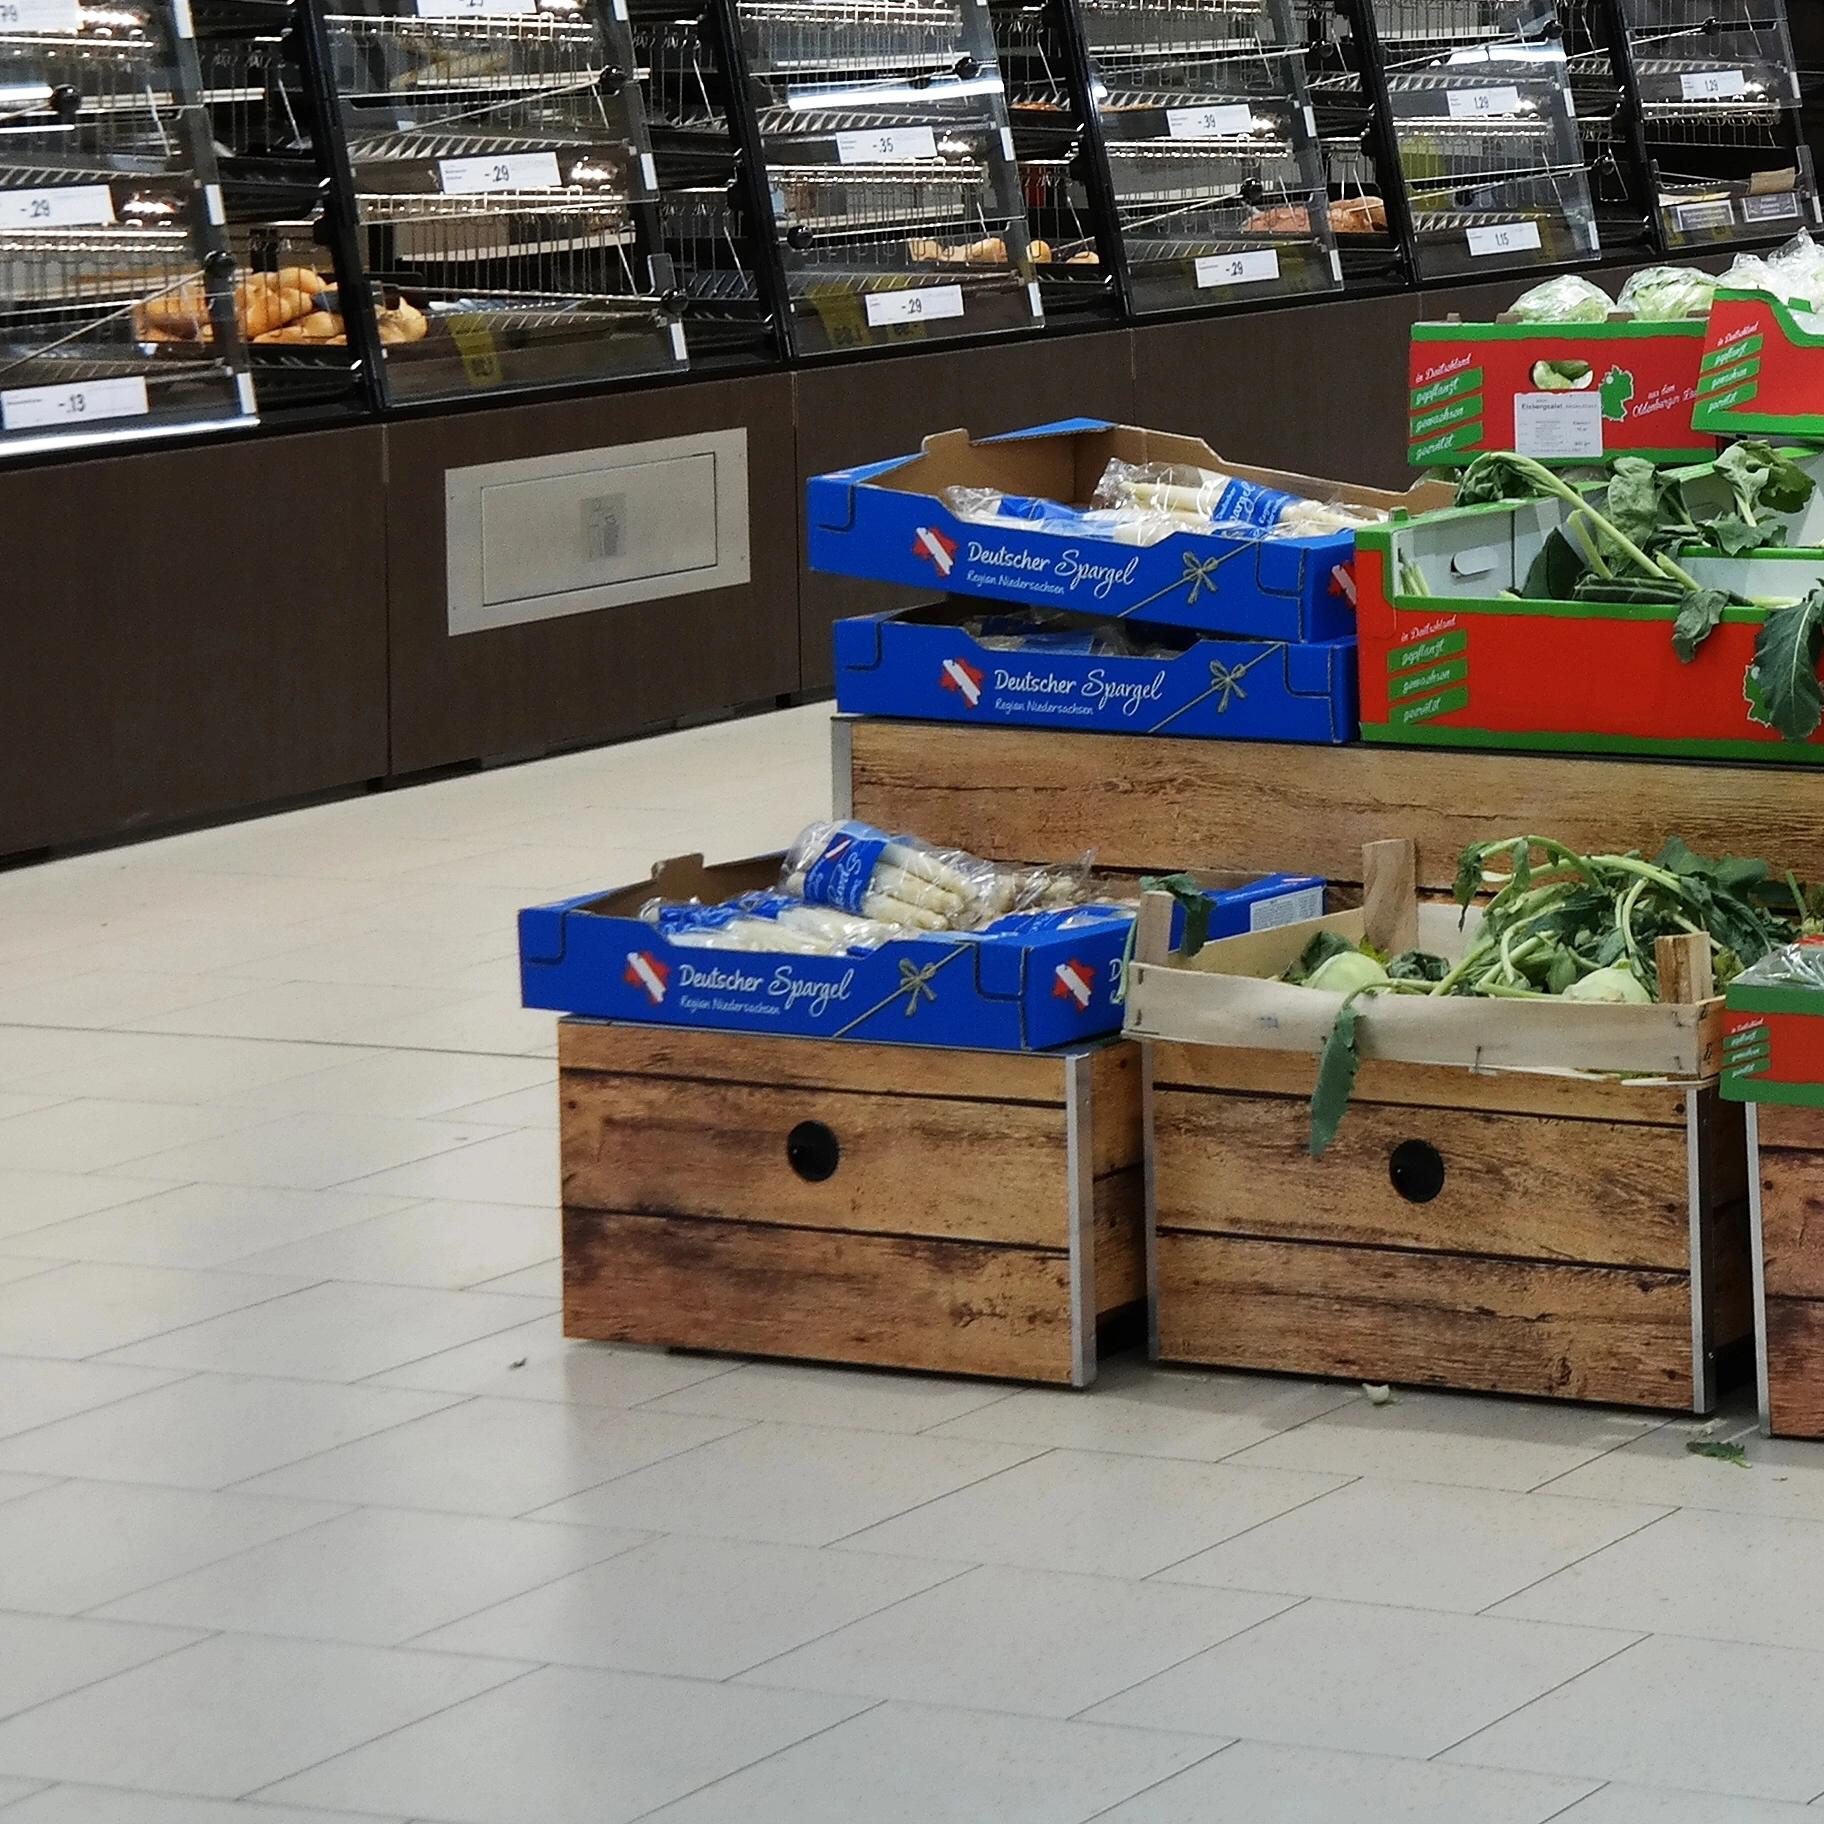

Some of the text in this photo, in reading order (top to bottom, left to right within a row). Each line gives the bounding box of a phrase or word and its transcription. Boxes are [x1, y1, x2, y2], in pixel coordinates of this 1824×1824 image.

[966, 570, 1065, 595] Region Niedersachsen
[968, 541, 1139, 599] Deutscher Spargel
[994, 668, 1166, 717] Deutscher Spargel
[995, 698, 1094, 716] Region Niedersachsen
[679, 964, 855, 1018] Deutscher Spargel
